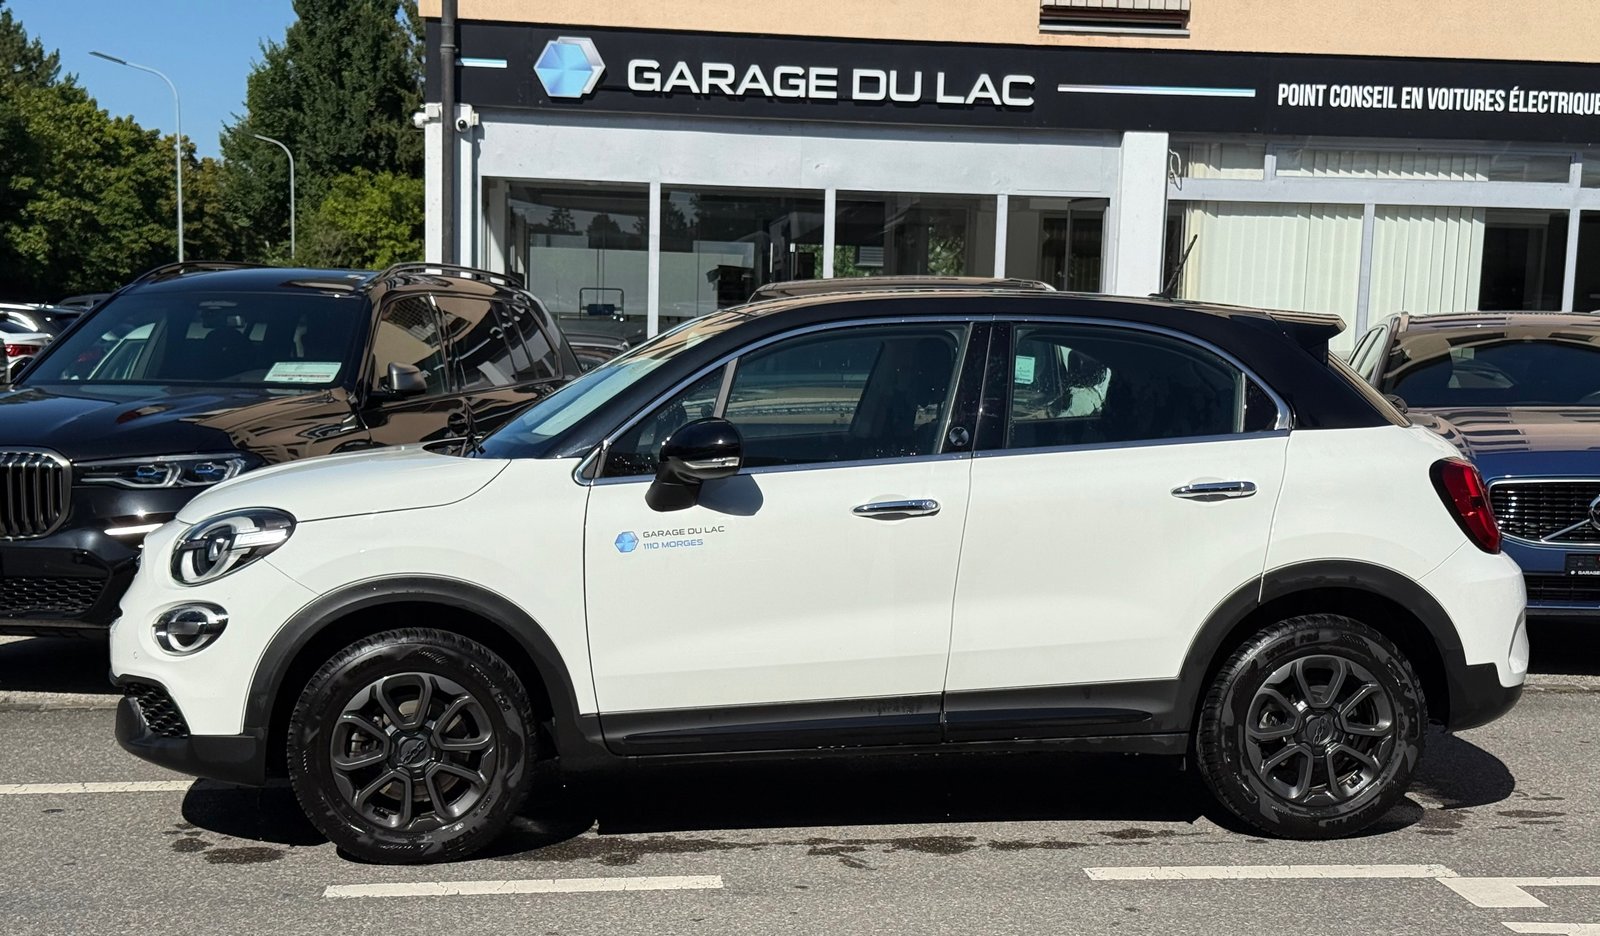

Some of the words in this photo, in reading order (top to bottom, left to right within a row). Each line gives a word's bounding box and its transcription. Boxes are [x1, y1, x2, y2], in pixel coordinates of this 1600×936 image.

[627, 59, 838, 100] GARAGE
[852, 68, 922, 102] DU
[936, 71, 1036, 107] LAC
[1277, 83, 1328, 108] POINT
[1329, 84, 1398, 110] CONSEIL
[1400, 86, 1424, 110] EN
[1427, 87, 1506, 113] VOITURES
[643, 528, 685, 538] GARAGE
[704, 525, 725, 534] LAC
[643, 541, 660, 550] 1110
[661, 539, 703, 549] MORGES
